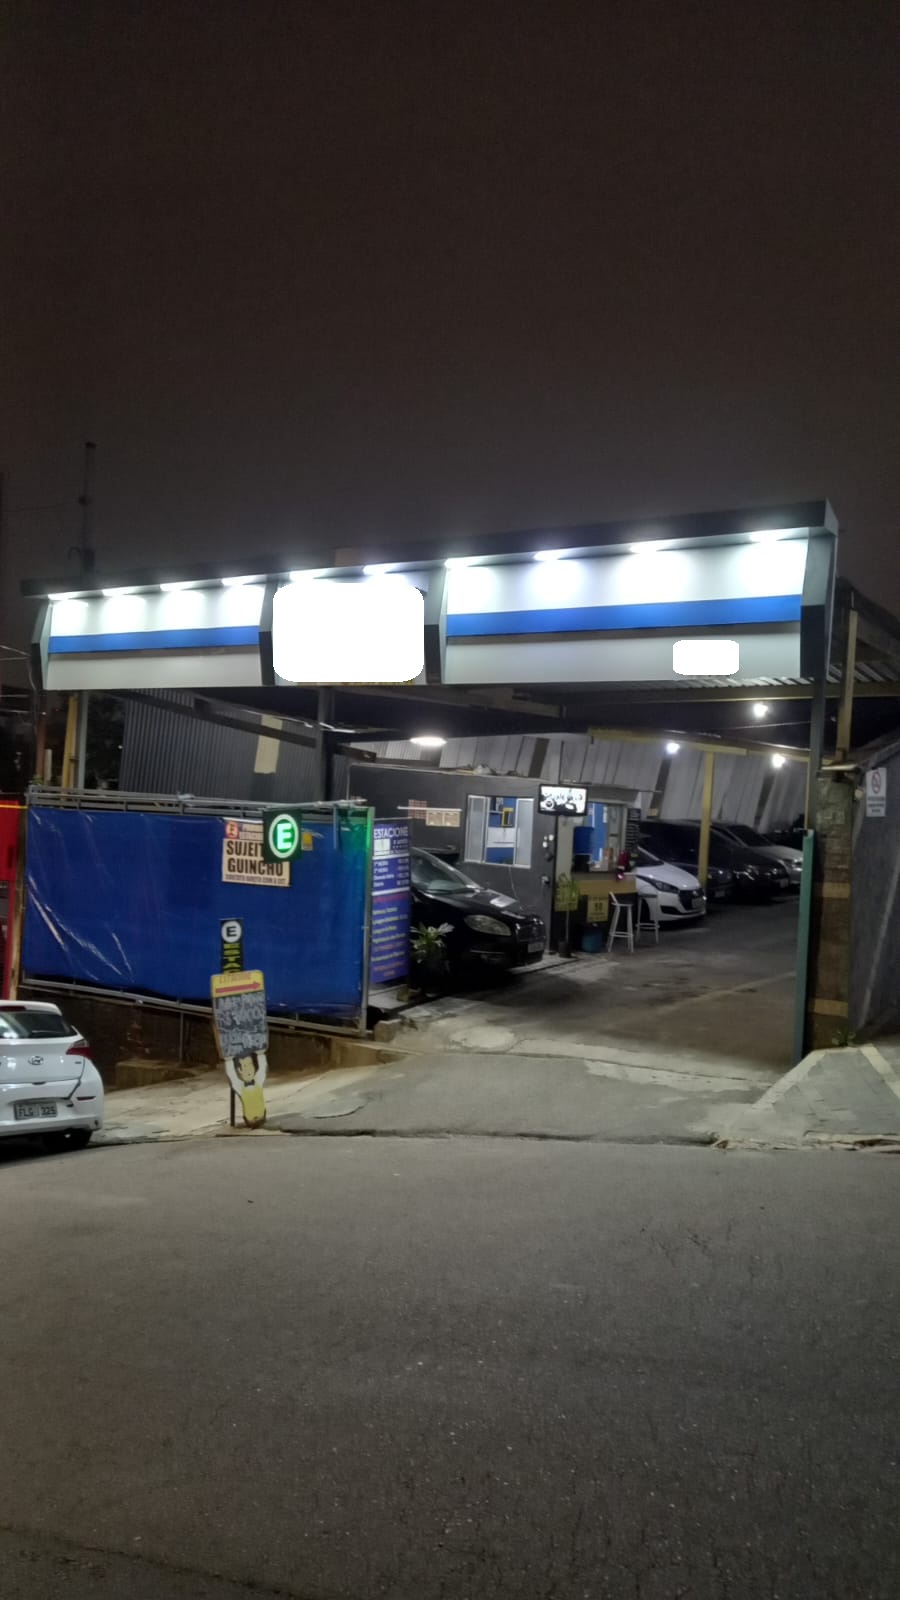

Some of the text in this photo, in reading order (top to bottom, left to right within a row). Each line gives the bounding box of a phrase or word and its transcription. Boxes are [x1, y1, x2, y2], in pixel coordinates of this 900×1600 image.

[277, 822, 292, 850] E
[226, 840, 264, 858] SUJEIT
[226, 925, 238, 938] E
